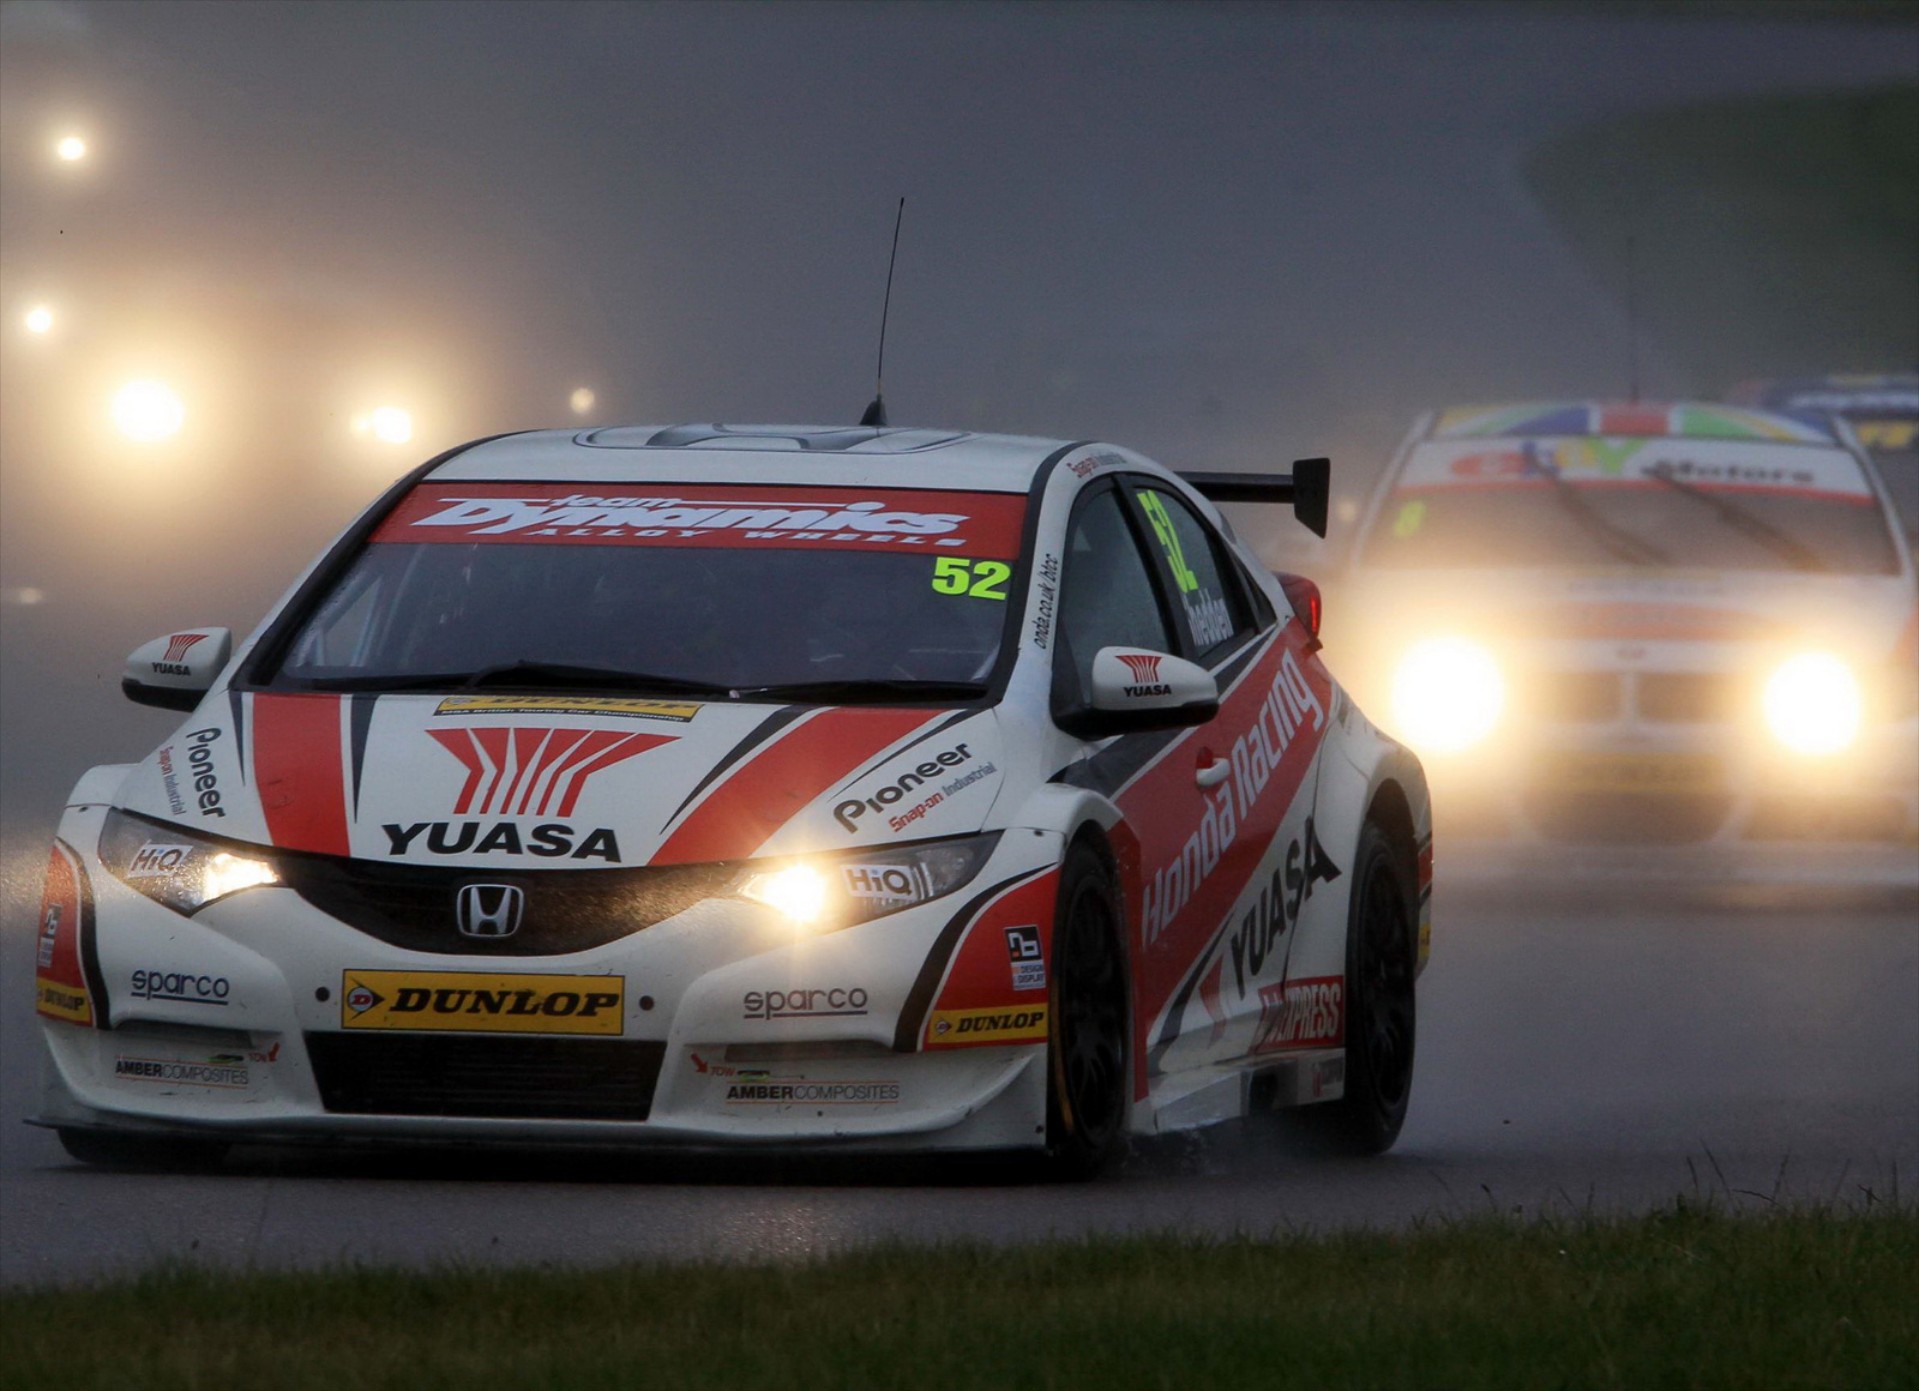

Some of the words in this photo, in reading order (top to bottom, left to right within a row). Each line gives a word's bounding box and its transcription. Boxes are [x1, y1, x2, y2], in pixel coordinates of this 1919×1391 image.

[409, 498, 970, 535] Dynamics
[551, 494, 682, 508] team
[522, 528, 714, 538] ALLOY
[744, 531, 967, 546] WHEELS
[932, 557, 1011, 600] 52
[152, 662, 191, 676] YUASA
[1124, 684, 1172, 697] YUASA
[186, 728, 225, 818] Pioneer
[833, 743, 972, 834] Pioneer
[889, 792, 944, 833] Snap-on
[941, 761, 997, 797] Industrial
[1140, 780, 1236, 953] Honda
[1232, 648, 1324, 820] Racing
[381, 822, 621, 863] YUASA
[131, 848, 182, 873] HiQ
[846, 868, 913, 896] HiQ
[1231, 815, 1342, 1001] YUASA
[131, 969, 229, 1000] sparco
[389, 988, 620, 1017] DUNLOP
[744, 988, 868, 1020] sparco
[956, 1012, 1044, 1033] DUNLOP
[710, 1066, 736, 1076] TOW
